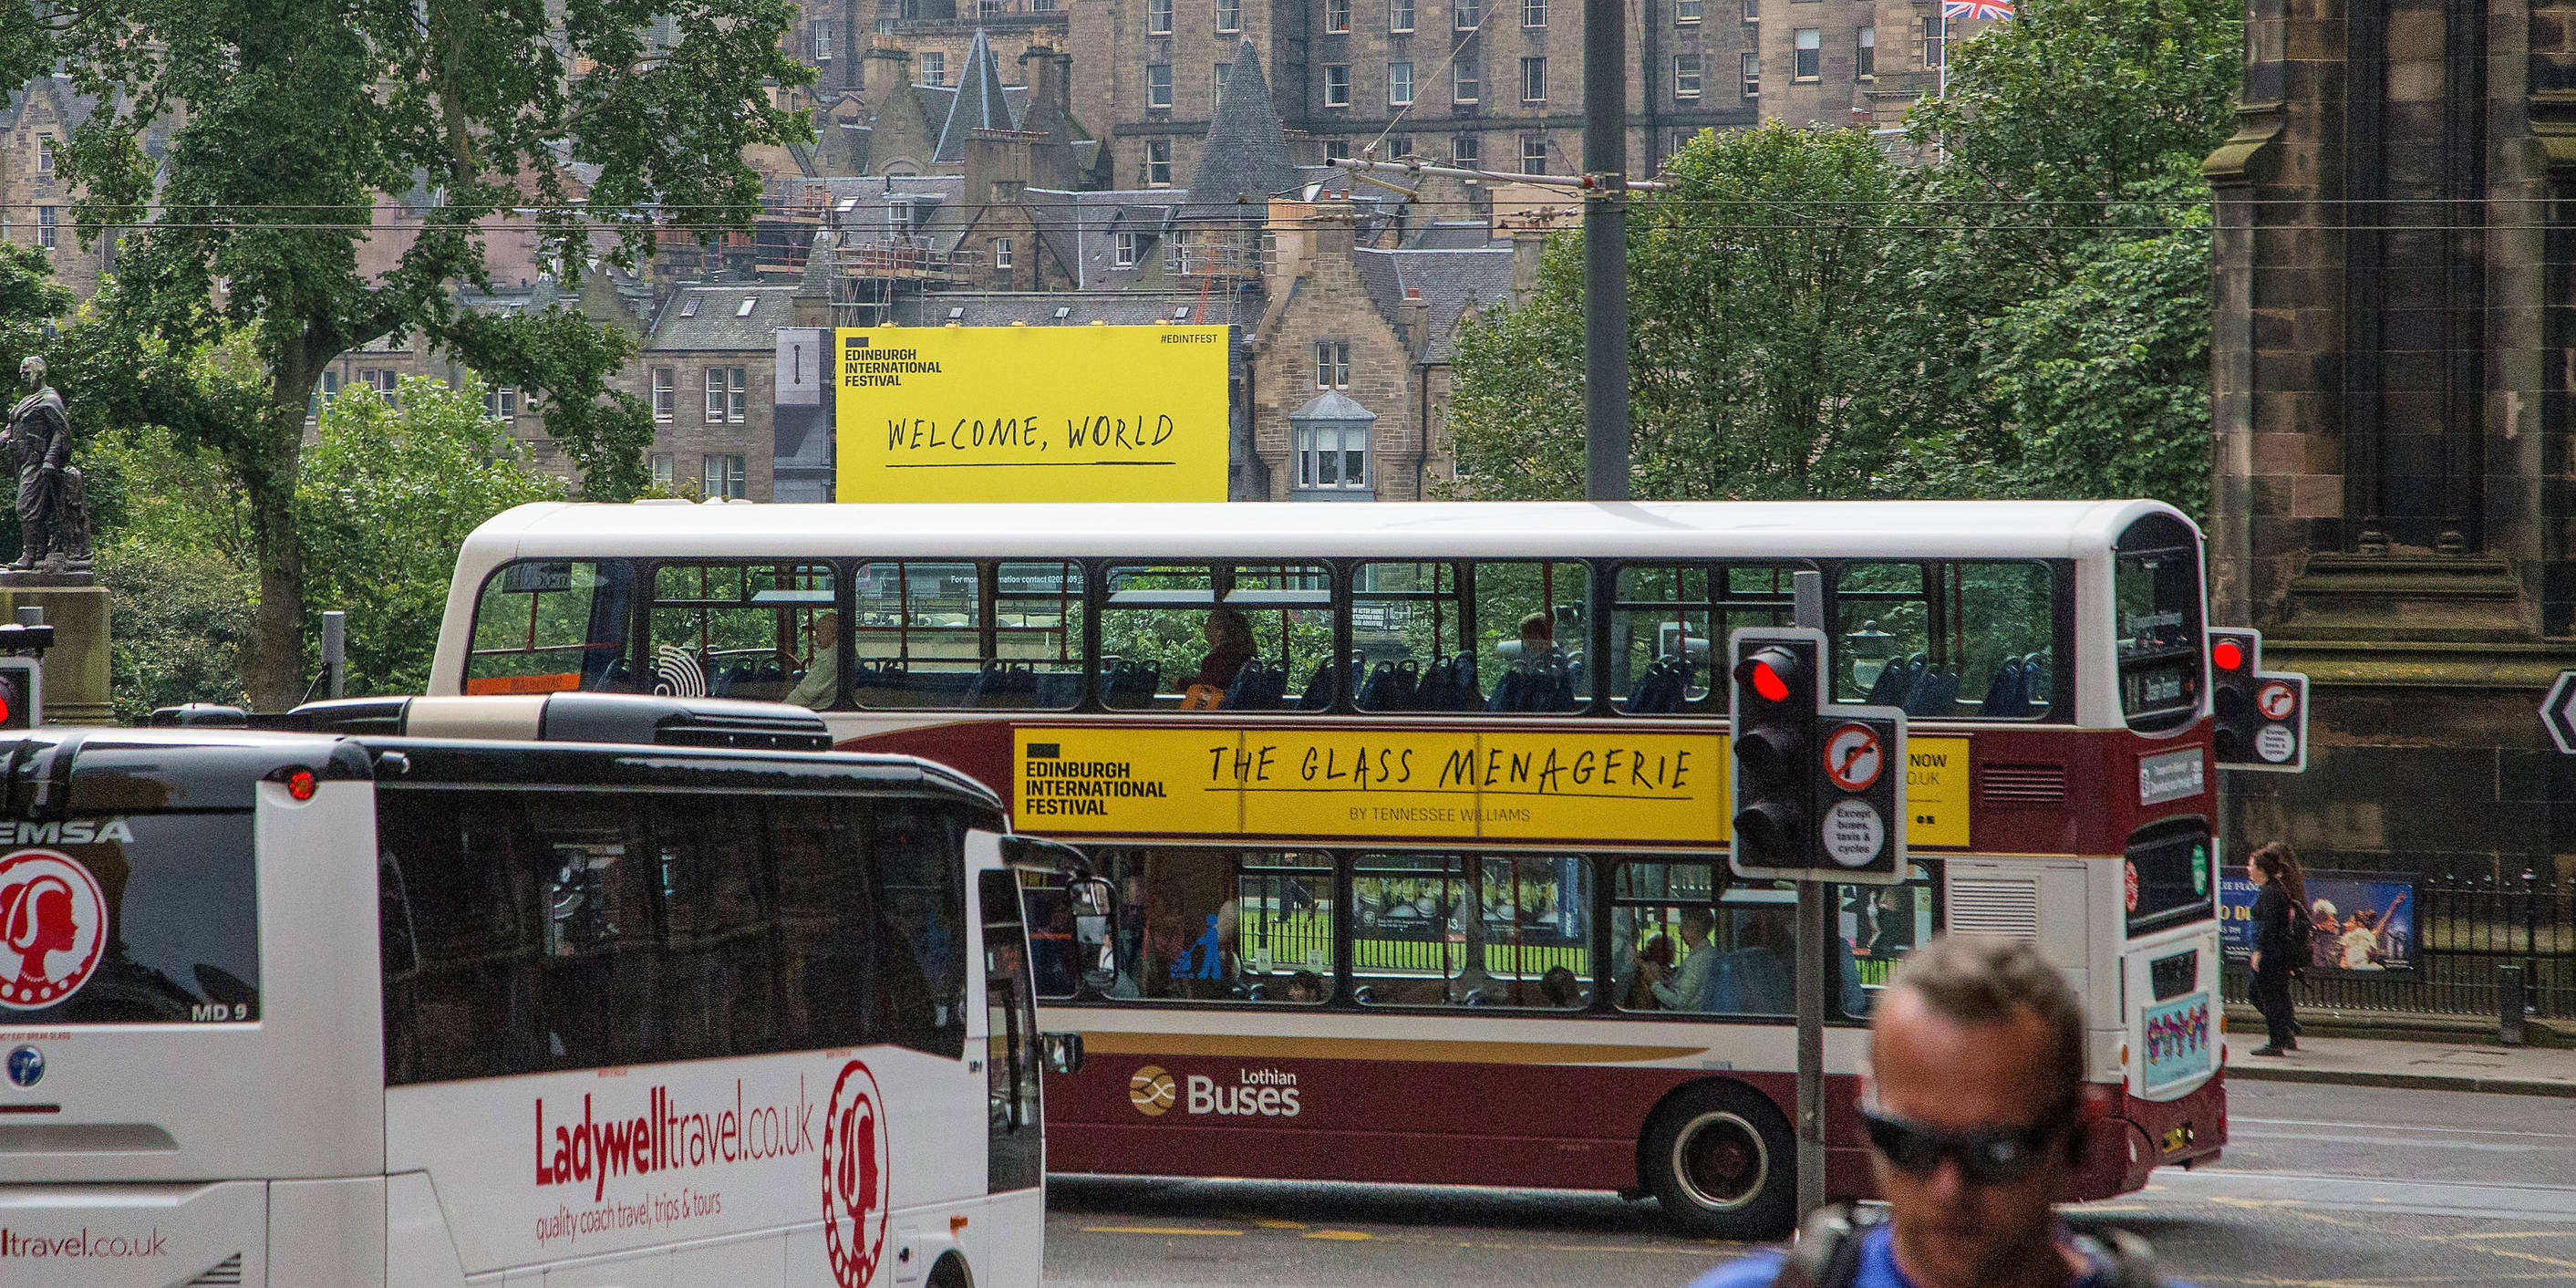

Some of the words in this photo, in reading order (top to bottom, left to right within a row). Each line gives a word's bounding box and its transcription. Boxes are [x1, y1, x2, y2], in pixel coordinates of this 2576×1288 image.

[1160, 334, 1218, 344] #EDINTFEST
[845, 349, 917, 361] EDINBURGH
[845, 362, 943, 374] INTERNATIONAL
[845, 375, 902, 387] FESTIVAL
[888, 416, 1049, 452] WELCOME,
[1067, 414, 1174, 451] WORLD
[950, 575, 962, 584] For
[1021, 575, 1047, 584] contact
[1909, 753, 1948, 768] NOW
[1026, 761, 1131, 778] EDINBURGH
[1209, 745, 1278, 784] THE
[1301, 746, 1413, 791] GLASS
[1439, 747, 1692, 795] MENAGERIE
[1907, 771, 1940, 786] O.UK
[1026, 780, 1168, 798] INTERNATIONAL
[1026, 798, 1109, 815] FESTIVAL
[1350, 806, 1367, 821] BY
[1372, 807, 1455, 822] TENNESSEE
[1460, 808, 1532, 822] WILLIAMS
[1836, 807, 1872, 820] Except
[1836, 832, 1860, 841] taxis
[1862, 831, 1871, 842] &
[1836, 845, 1871, 856] cycles
[191, 1005, 229, 1022] MD
[234, 1005, 248, 1020] 9
[1241, 1068, 1297, 1085] Lothian
[1188, 1075, 1300, 1117] Buses
[535, 1072, 814, 1203] Ladywelltravel.co.uk
[535, 1204, 577, 1248] quality
[579, 1198, 615, 1233] coach
[617, 1193, 652, 1230] travel,
[655, 1192, 679, 1226] trips
[681, 1188, 691, 1220] &
[693, 1189, 721, 1218] tours
